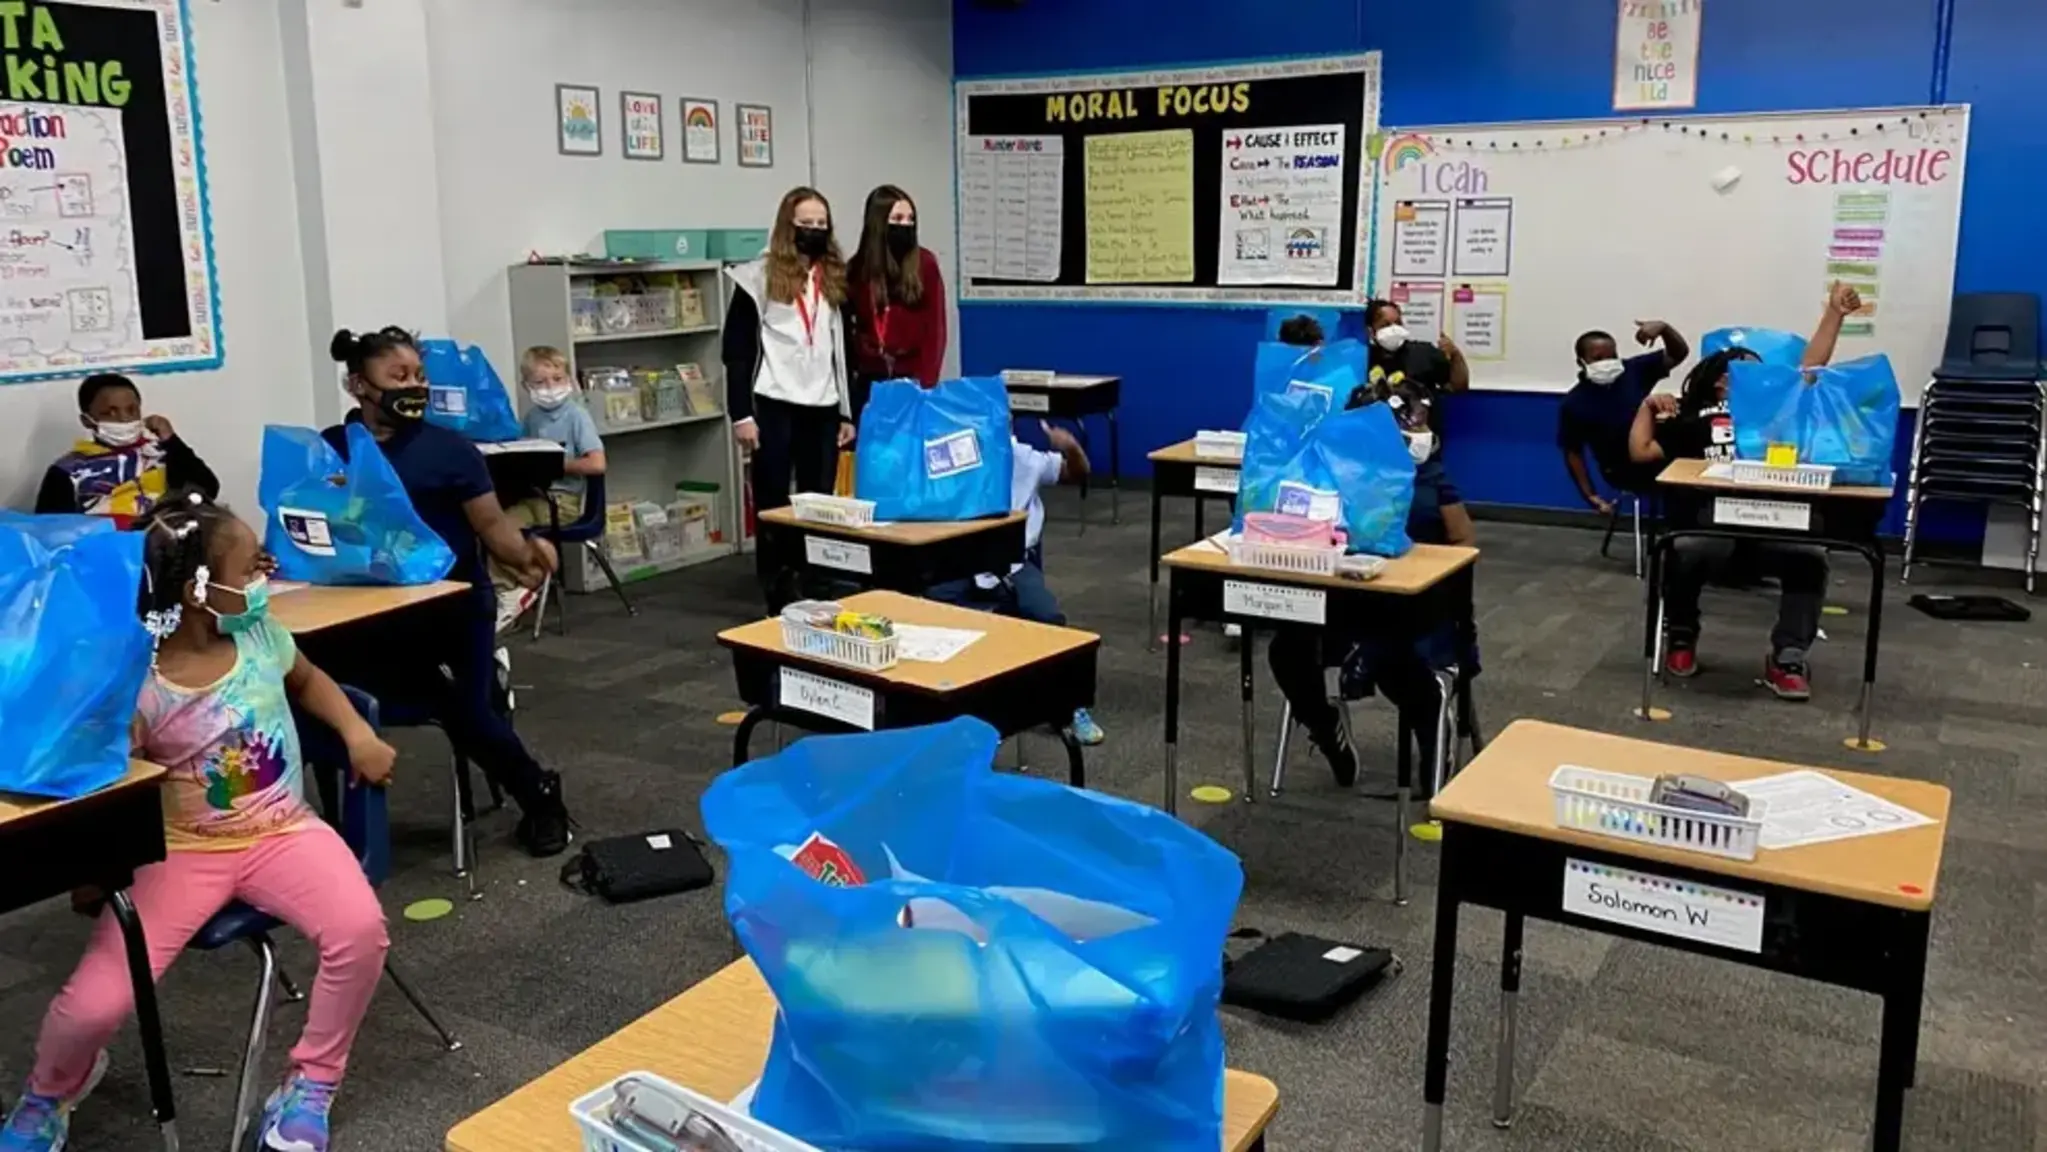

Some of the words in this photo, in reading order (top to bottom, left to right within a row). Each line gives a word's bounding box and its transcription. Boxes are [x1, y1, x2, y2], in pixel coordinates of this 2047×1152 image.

[1046, 90, 1138, 122] MORAL
[1158, 83, 1250, 116] FOCUS
[629, 133, 659, 150] LIFE
[1245, 133, 1282, 148] CAUSE
[1294, 132, 1338, 147] EFFECT
[1293, 154, 1340, 169] REASON
[1421, 163, 1427, 194] I
[1436, 161, 1488, 195] Can
[1588, 882, 1678, 922] Solomon
[1685, 904, 1711, 928] W
